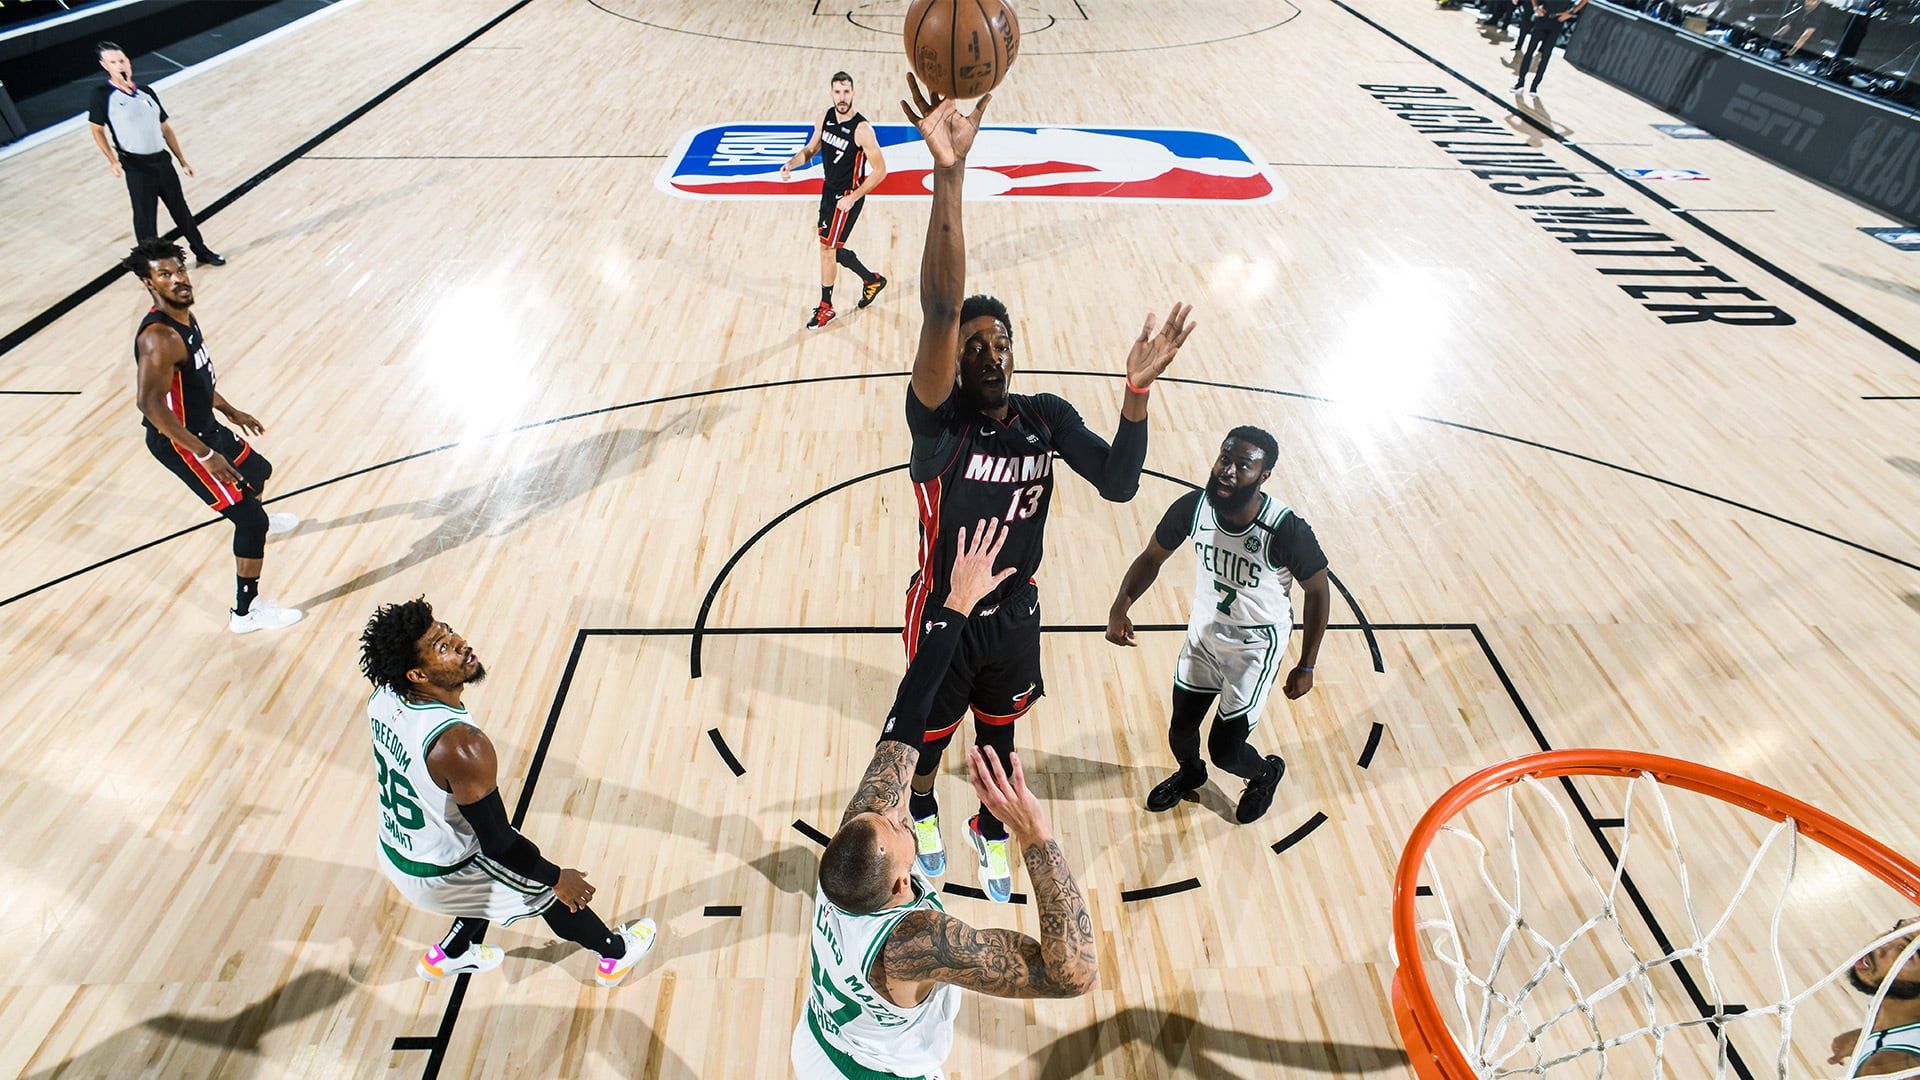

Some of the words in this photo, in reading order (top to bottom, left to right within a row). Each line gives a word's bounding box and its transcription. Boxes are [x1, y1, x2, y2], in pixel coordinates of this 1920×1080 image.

[1358, 84, 1514, 136] BLACK
[1722, 83, 1825, 151] ESPN
[708, 132, 808, 166] NBA
[821, 130, 849, 149] MIAMI
[833, 151, 844, 164] 7
[1432, 141, 1605, 197] LIVES
[1514, 204, 1797, 326] MATTER
[964, 450, 1053, 483] MIAMI
[1004, 485, 1044, 522] 13
[1195, 541, 1262, 588] CELTICS
[1213, 580, 1237, 616] 7
[373, 743, 426, 830] 36
[382, 811, 413, 851] SMART
